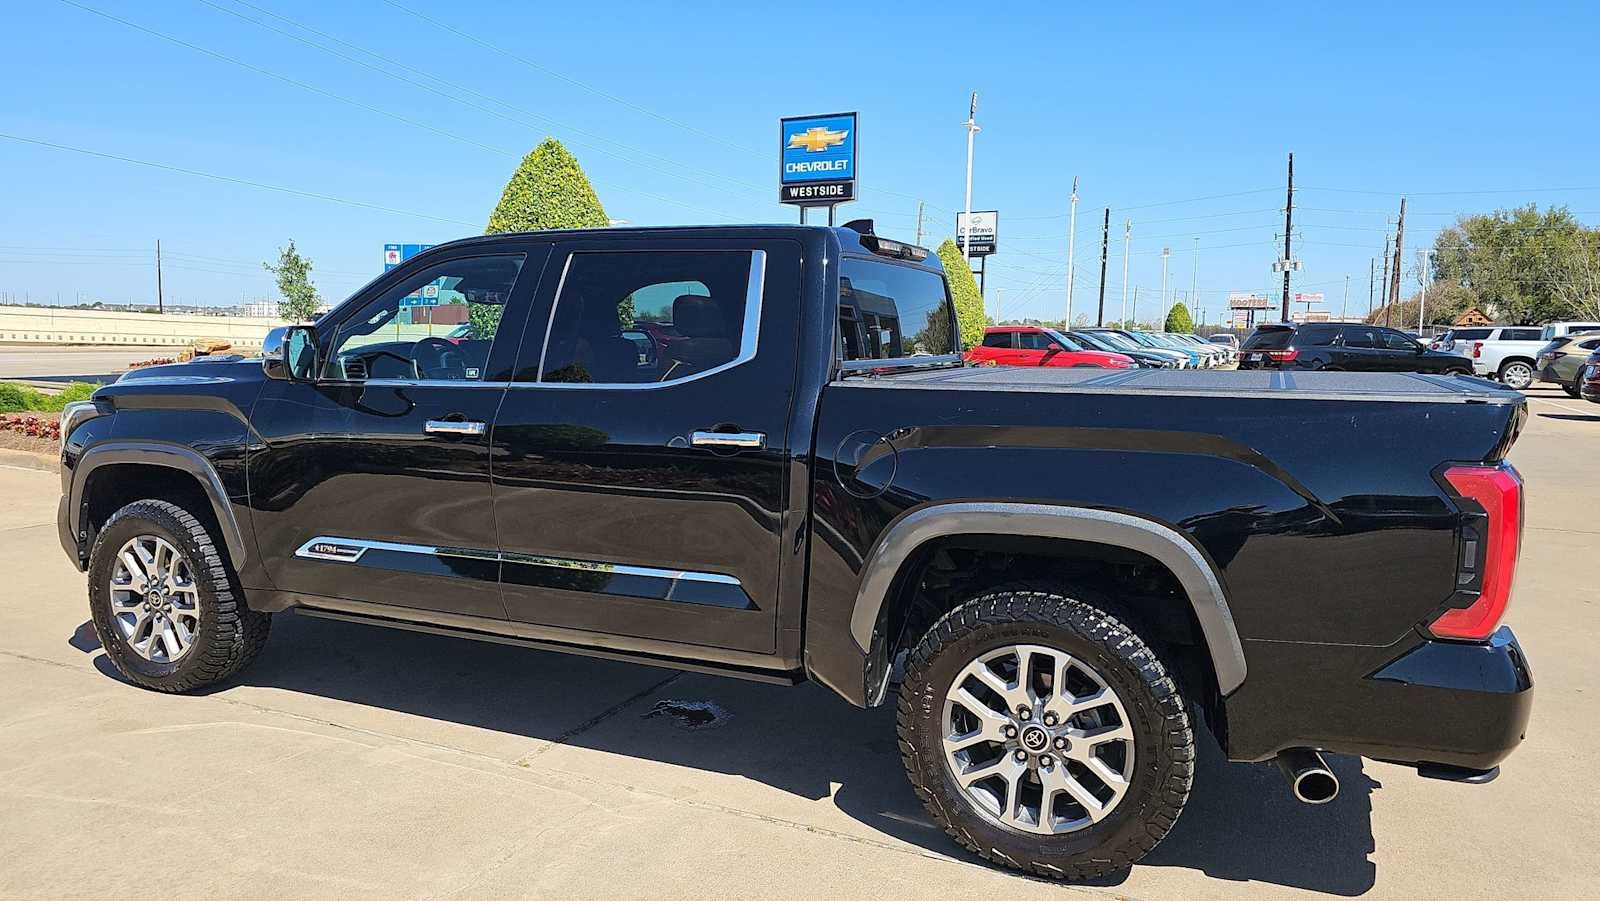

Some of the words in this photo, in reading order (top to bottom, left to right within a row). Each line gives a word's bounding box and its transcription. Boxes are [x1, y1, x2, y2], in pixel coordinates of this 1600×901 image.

[786, 160, 848, 173] CHEVROLET
[790, 185, 844, 197] WESTSIDE
[960, 226, 993, 234] CrBravo
